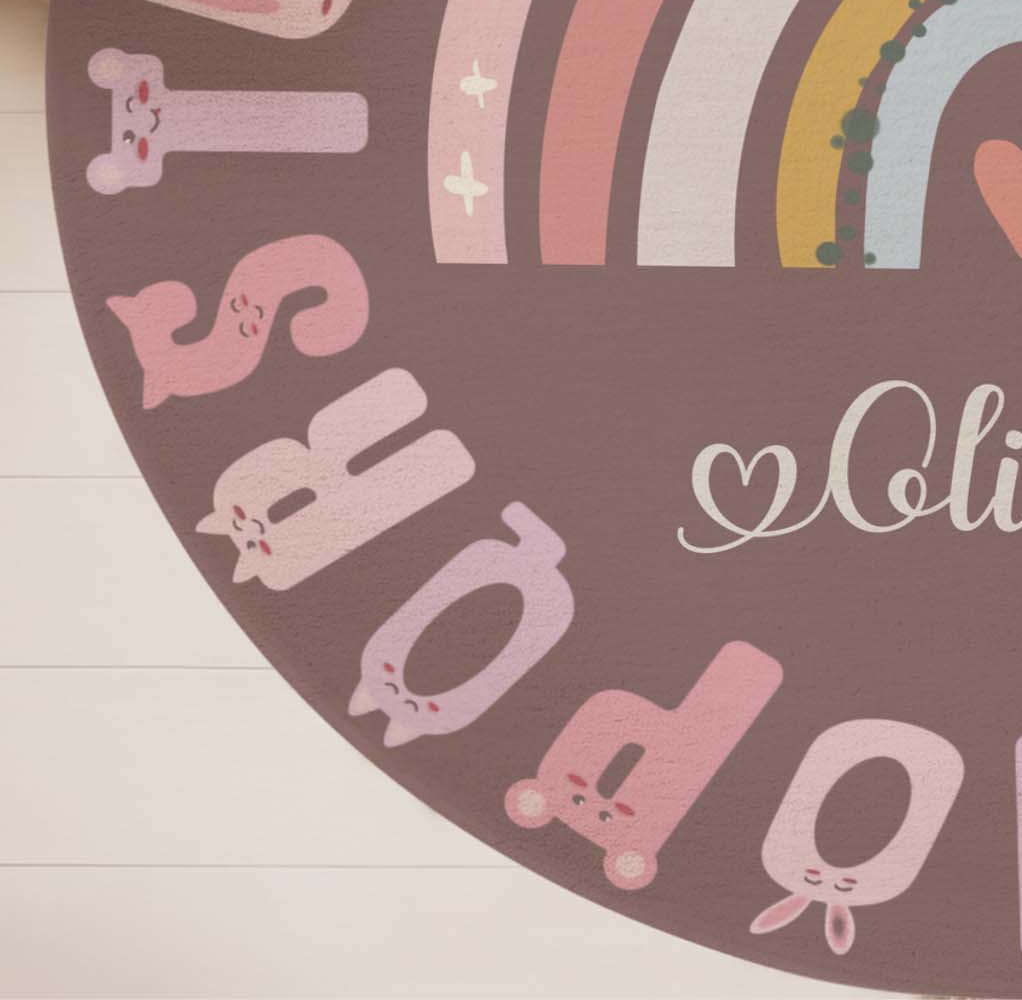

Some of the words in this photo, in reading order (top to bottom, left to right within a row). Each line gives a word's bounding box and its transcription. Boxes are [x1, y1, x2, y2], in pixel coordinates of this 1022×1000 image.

[86, 48, 368, 195] T
[105, 234, 369, 409] S
[195, 367, 476, 591] R
[348, 501, 575, 748] Q
[504, 640, 784, 890] P
[749, 718, 965, 955] O
